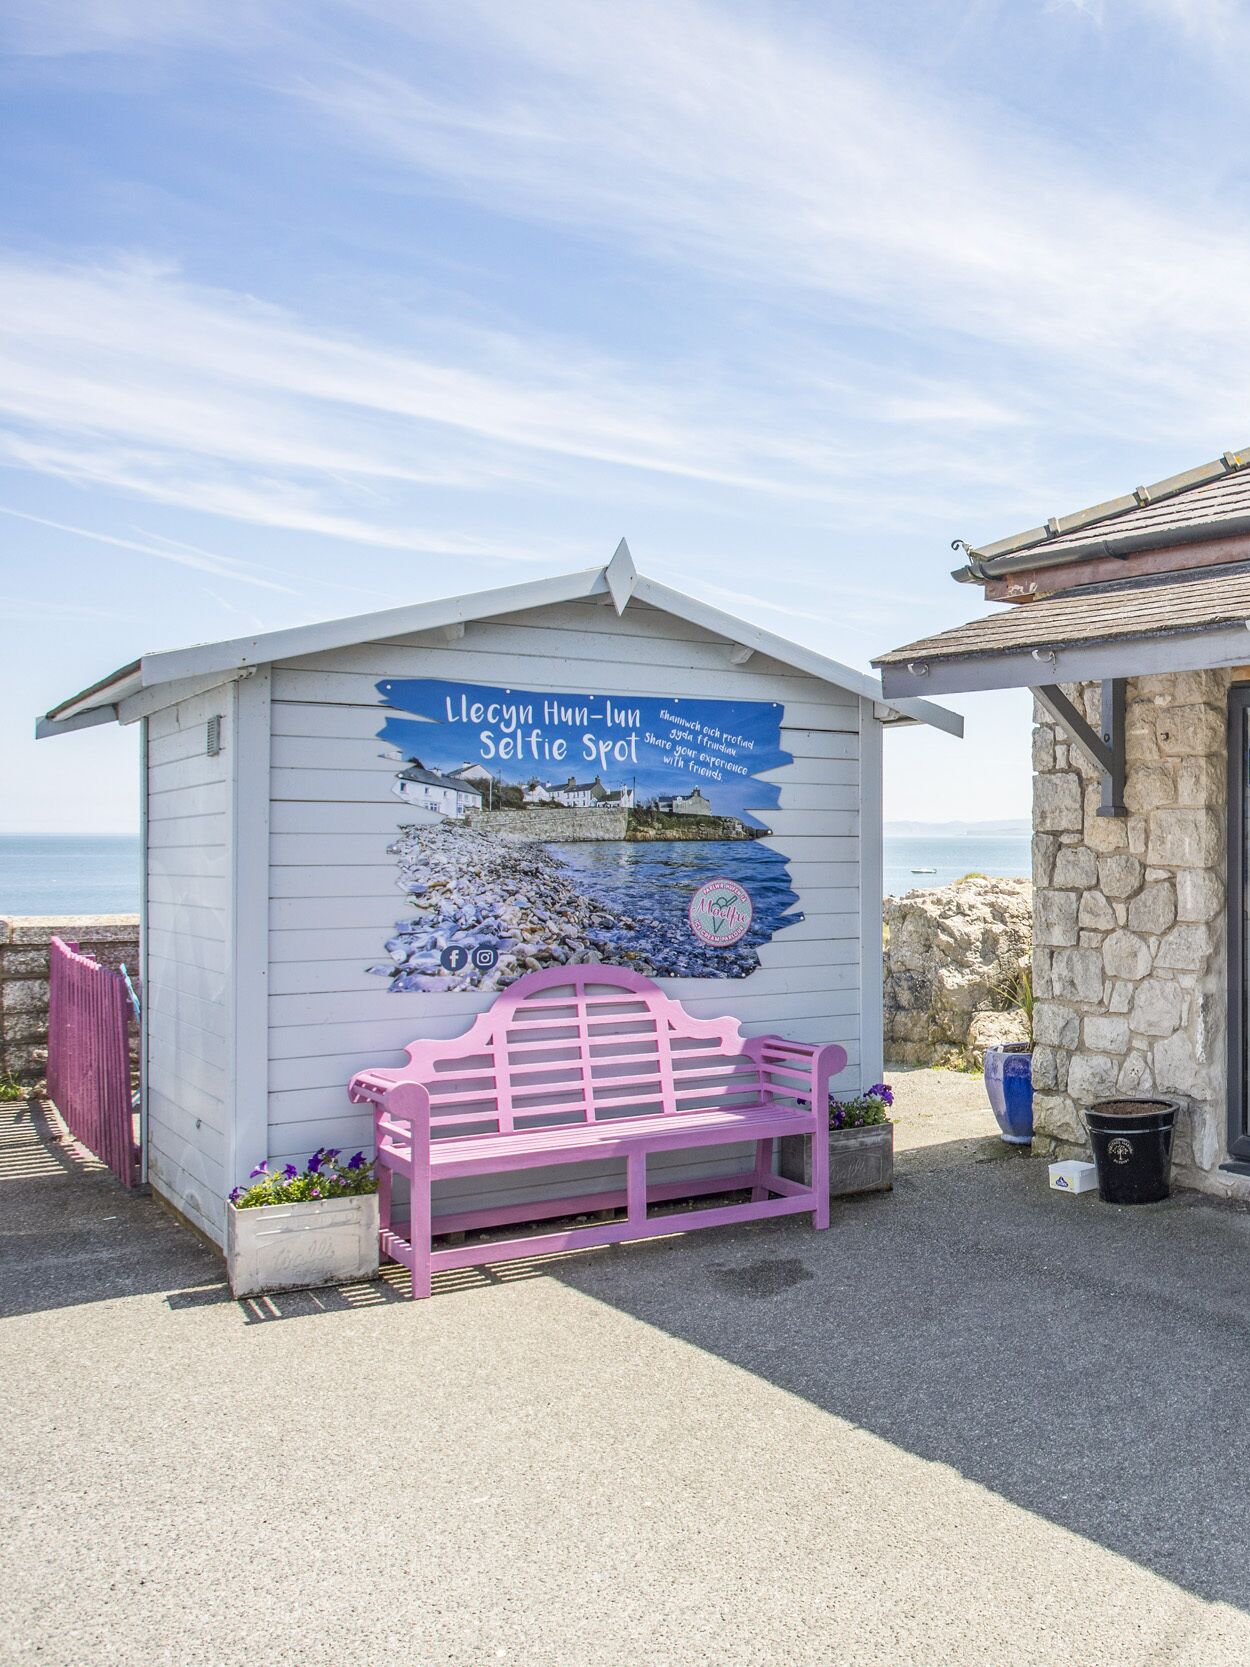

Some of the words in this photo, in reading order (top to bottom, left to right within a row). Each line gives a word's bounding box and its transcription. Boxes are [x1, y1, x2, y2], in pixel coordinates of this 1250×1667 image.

[446, 693, 533, 733] Llecyn
[544, 700, 641, 728] Hun-lun
[480, 729, 567, 760] Selfie
[582, 732, 640, 771] Spot
[669, 728, 694, 742] gyda
[703, 726, 721, 738] eich
[722, 733, 755, 750] profiad
[644, 732, 673, 750] Share
[674, 744, 698, 759] your
[699, 752, 748, 776] experience
[663, 755, 684, 769] with
